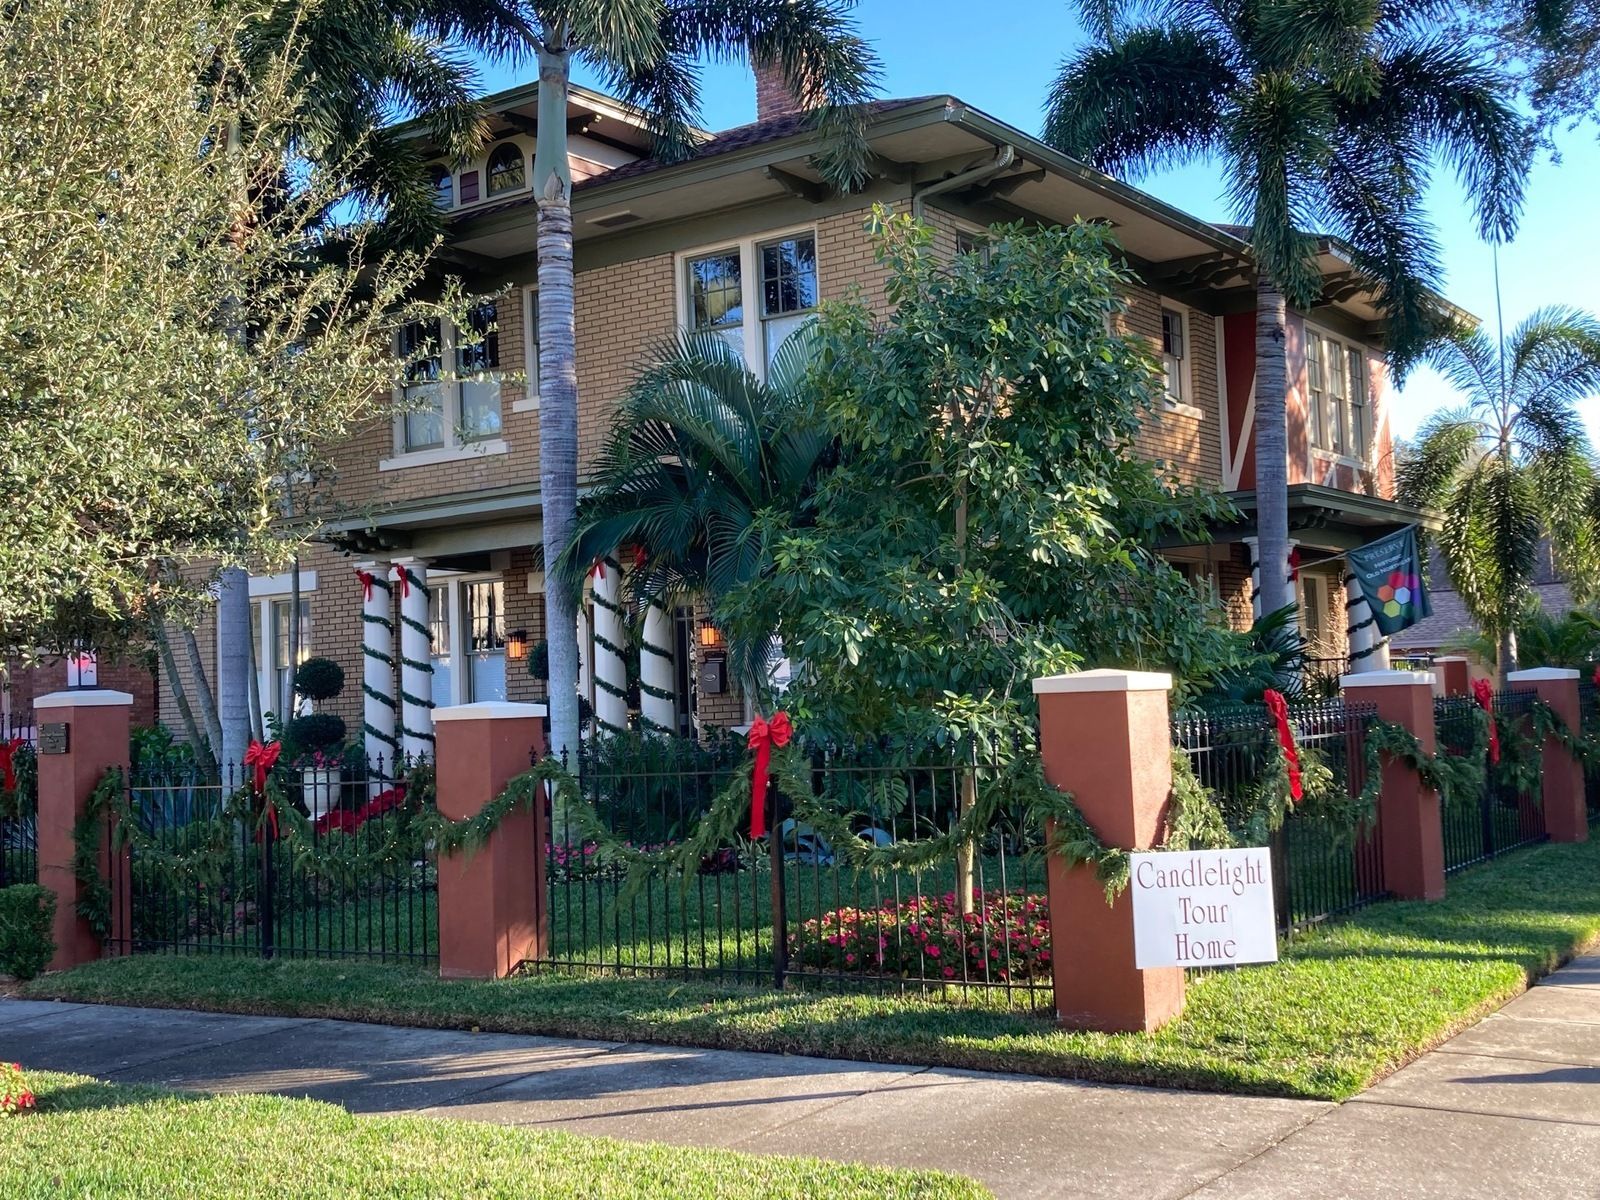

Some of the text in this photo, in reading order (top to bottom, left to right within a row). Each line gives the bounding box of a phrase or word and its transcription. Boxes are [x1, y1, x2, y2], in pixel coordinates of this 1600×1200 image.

[1364, 541, 1403, 561] PRESERVE
[1366, 571, 1380, 579] OLD
[1137, 855, 1266, 896] Candlelight
[1179, 895, 1228, 925] Tour
[1175, 933, 1237, 961] Home
